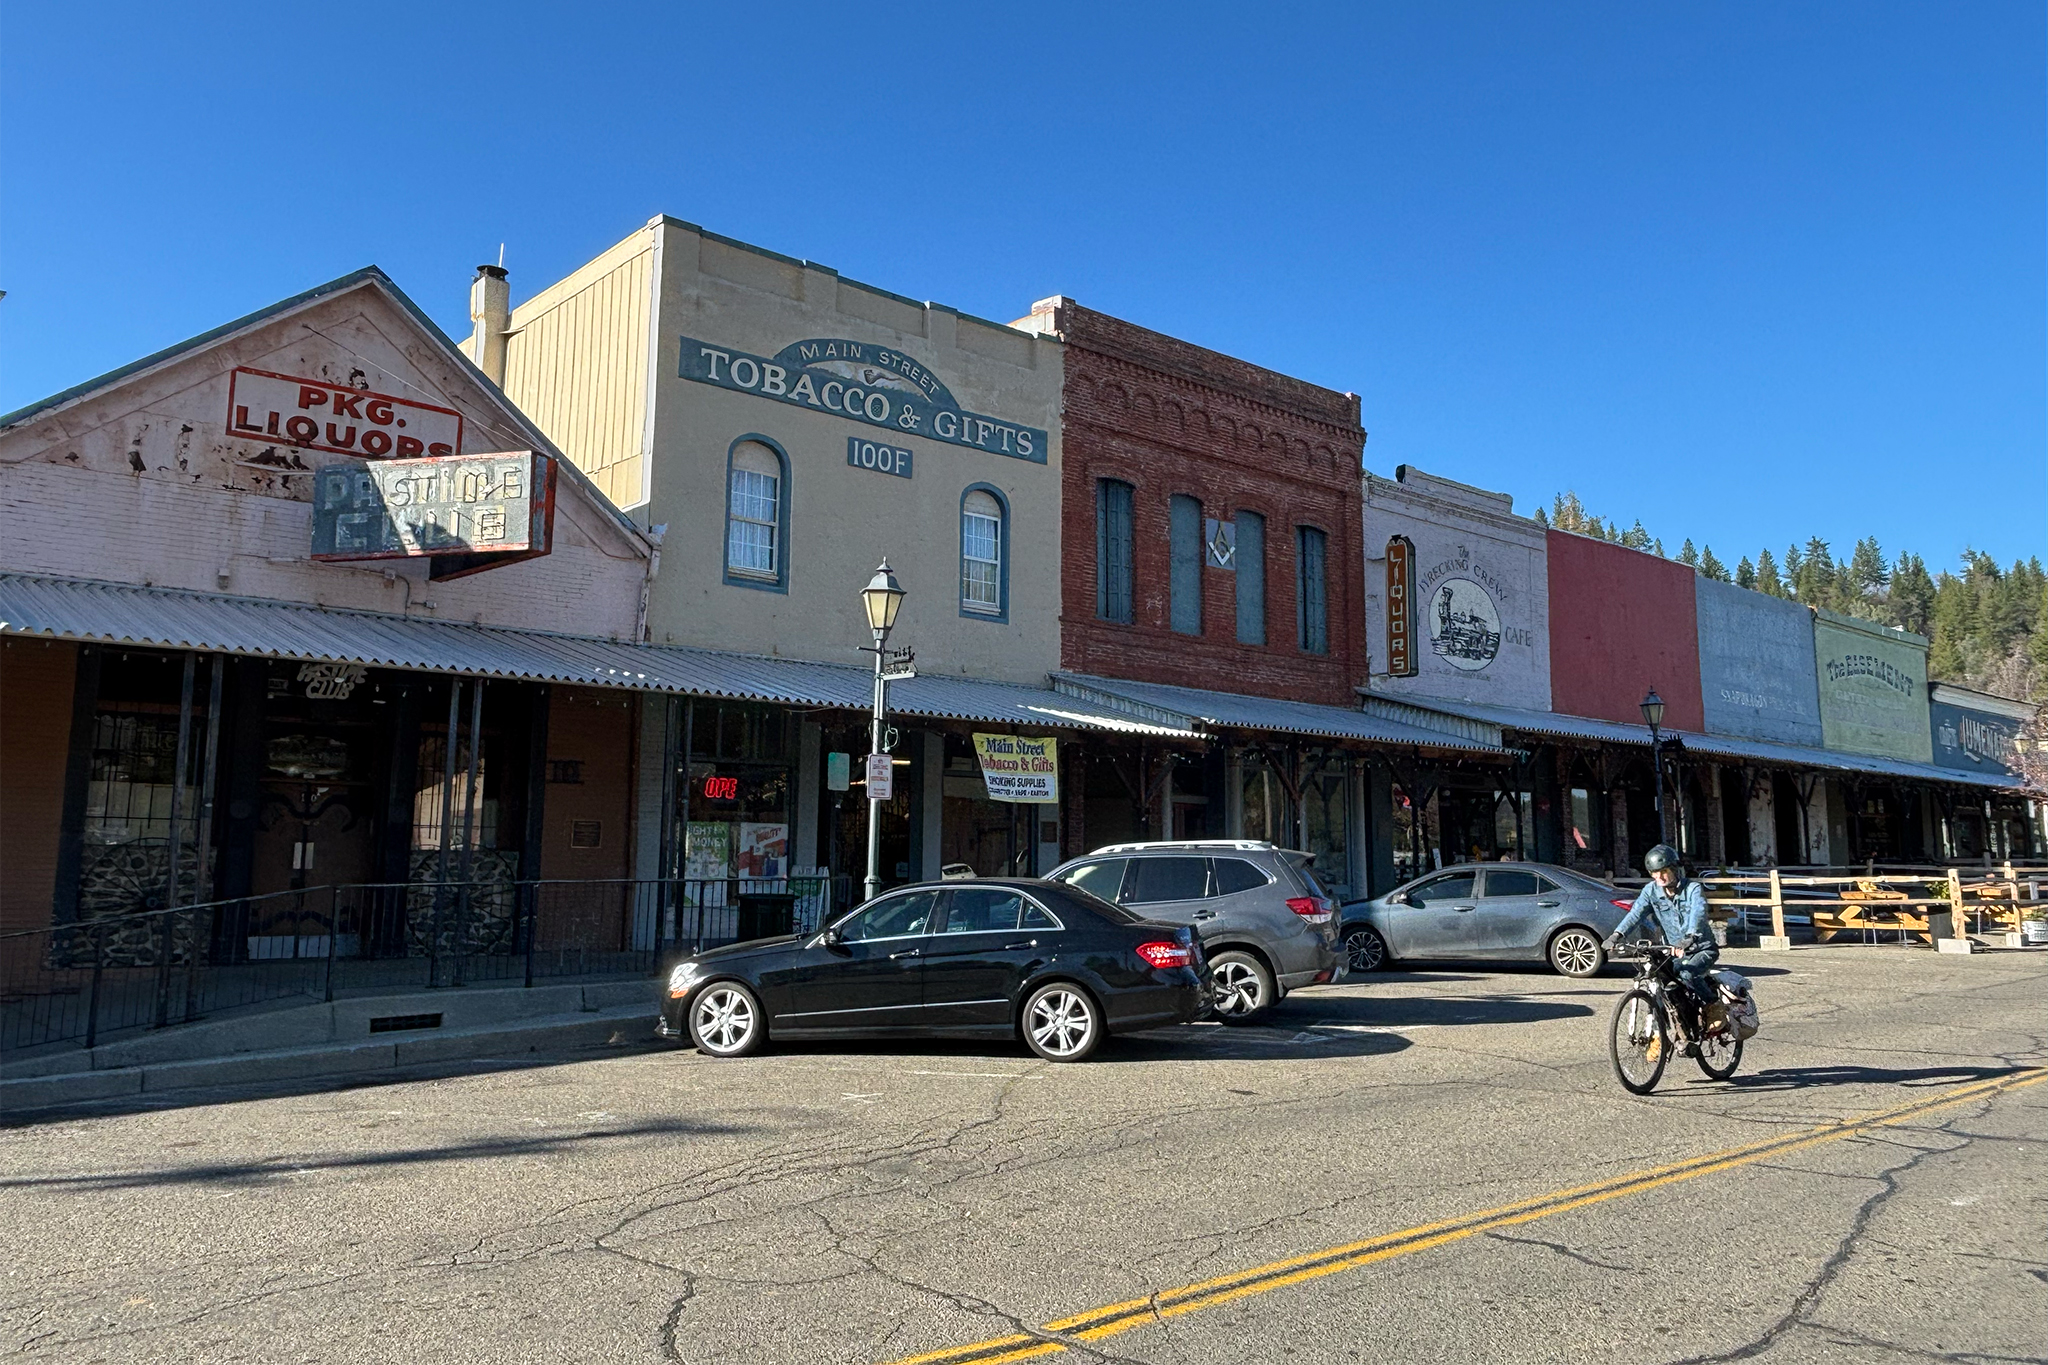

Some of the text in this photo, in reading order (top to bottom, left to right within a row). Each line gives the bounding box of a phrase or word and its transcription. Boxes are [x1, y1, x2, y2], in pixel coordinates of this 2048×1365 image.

[799, 343, 940, 396] MAIN STREET
[298, 385, 406, 428] PKG.
[700, 347, 1034, 457] TOBACCO & GIFTS
[1418, 558, 1508, 601] WRECKING CREW
[1389, 550, 1405, 670] LIQUORS
[1504, 626, 1533, 647] CAFE
[305, 676, 355, 700] CLUB
[979, 753, 1054, 773] Tobacco & Gifts
[985, 737, 1046, 756] Main Street
[1017, 777, 1046, 789] SUPPLIES
